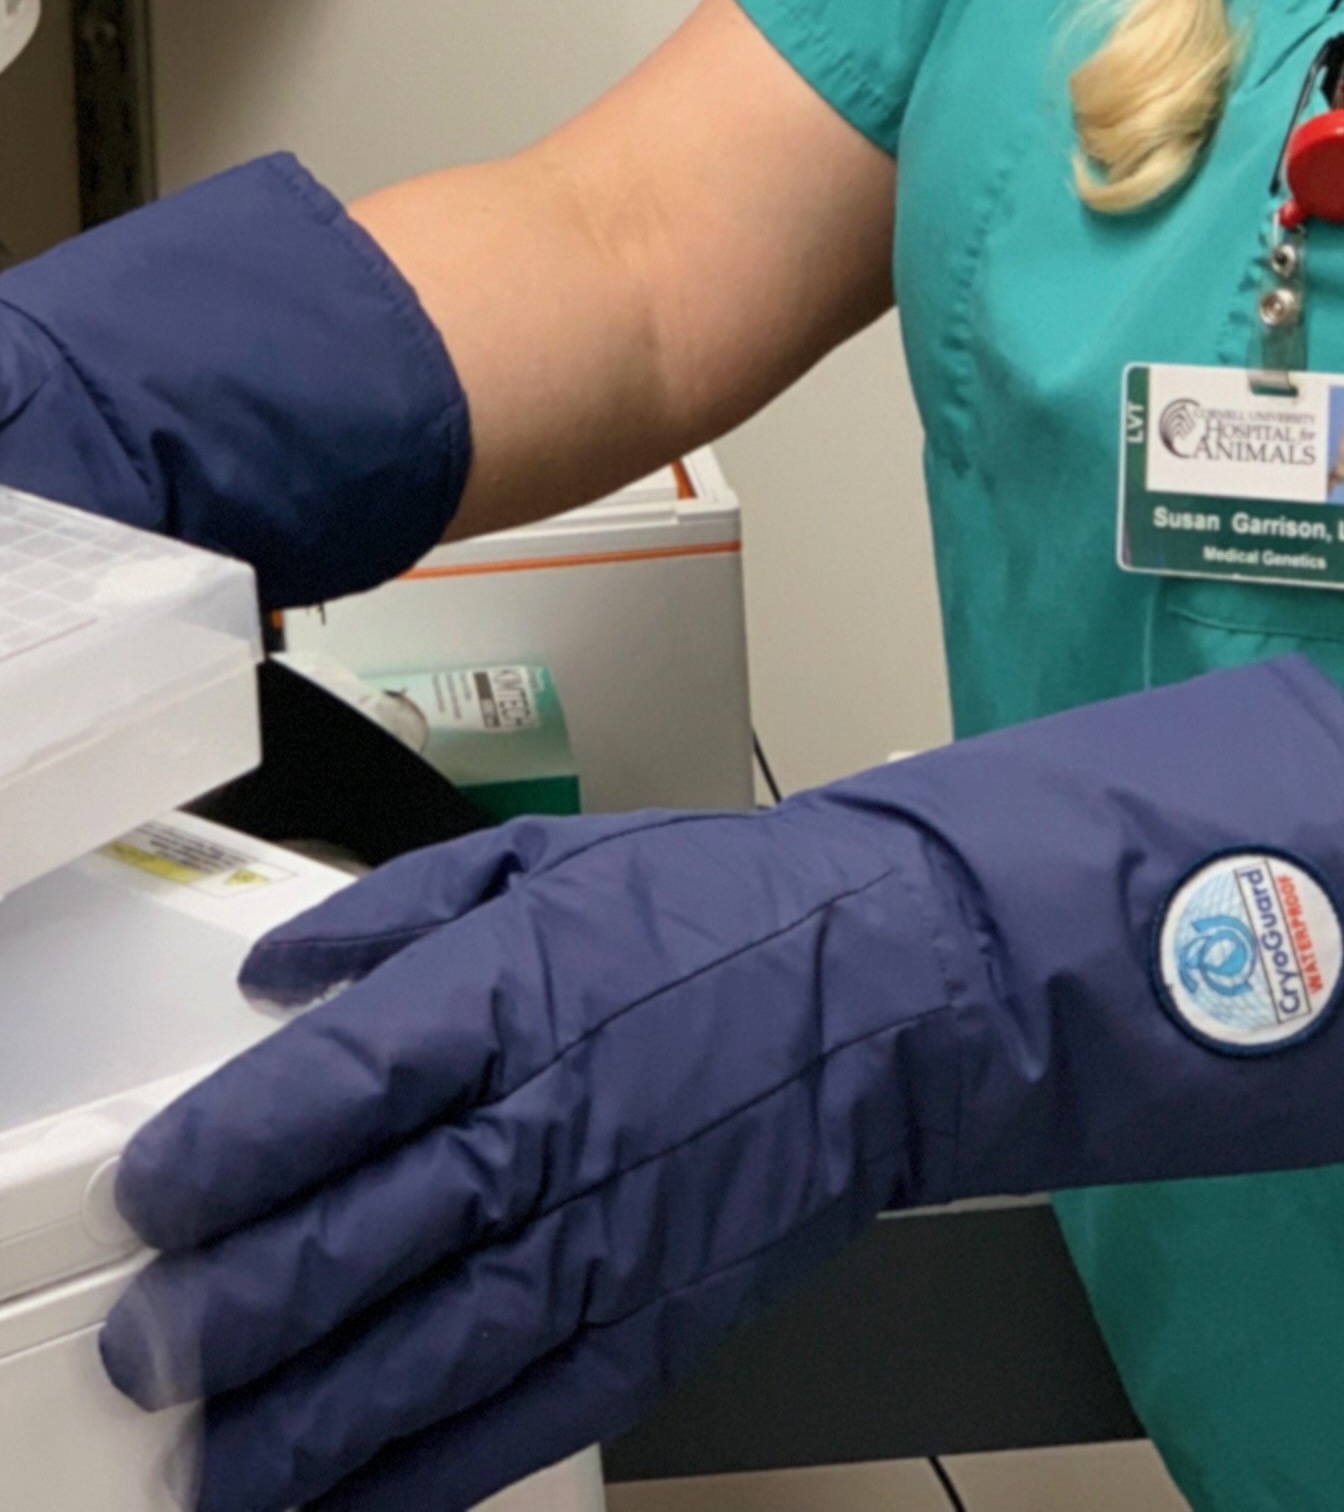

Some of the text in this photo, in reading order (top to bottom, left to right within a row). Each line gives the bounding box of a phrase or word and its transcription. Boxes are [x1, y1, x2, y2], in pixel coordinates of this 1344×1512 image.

[1126, 400, 1144, 444] LVT
[1205, 419, 1296, 442] HOSPITAL
[1153, 506, 1221, 531] Susan
[1231, 511, 1332, 543] Garrison,
[1203, 545, 1328, 570] Medical Genetics
[1239, 867, 1301, 1015] CryoGuard
[1277, 874, 1324, 995] WATERPROOF
